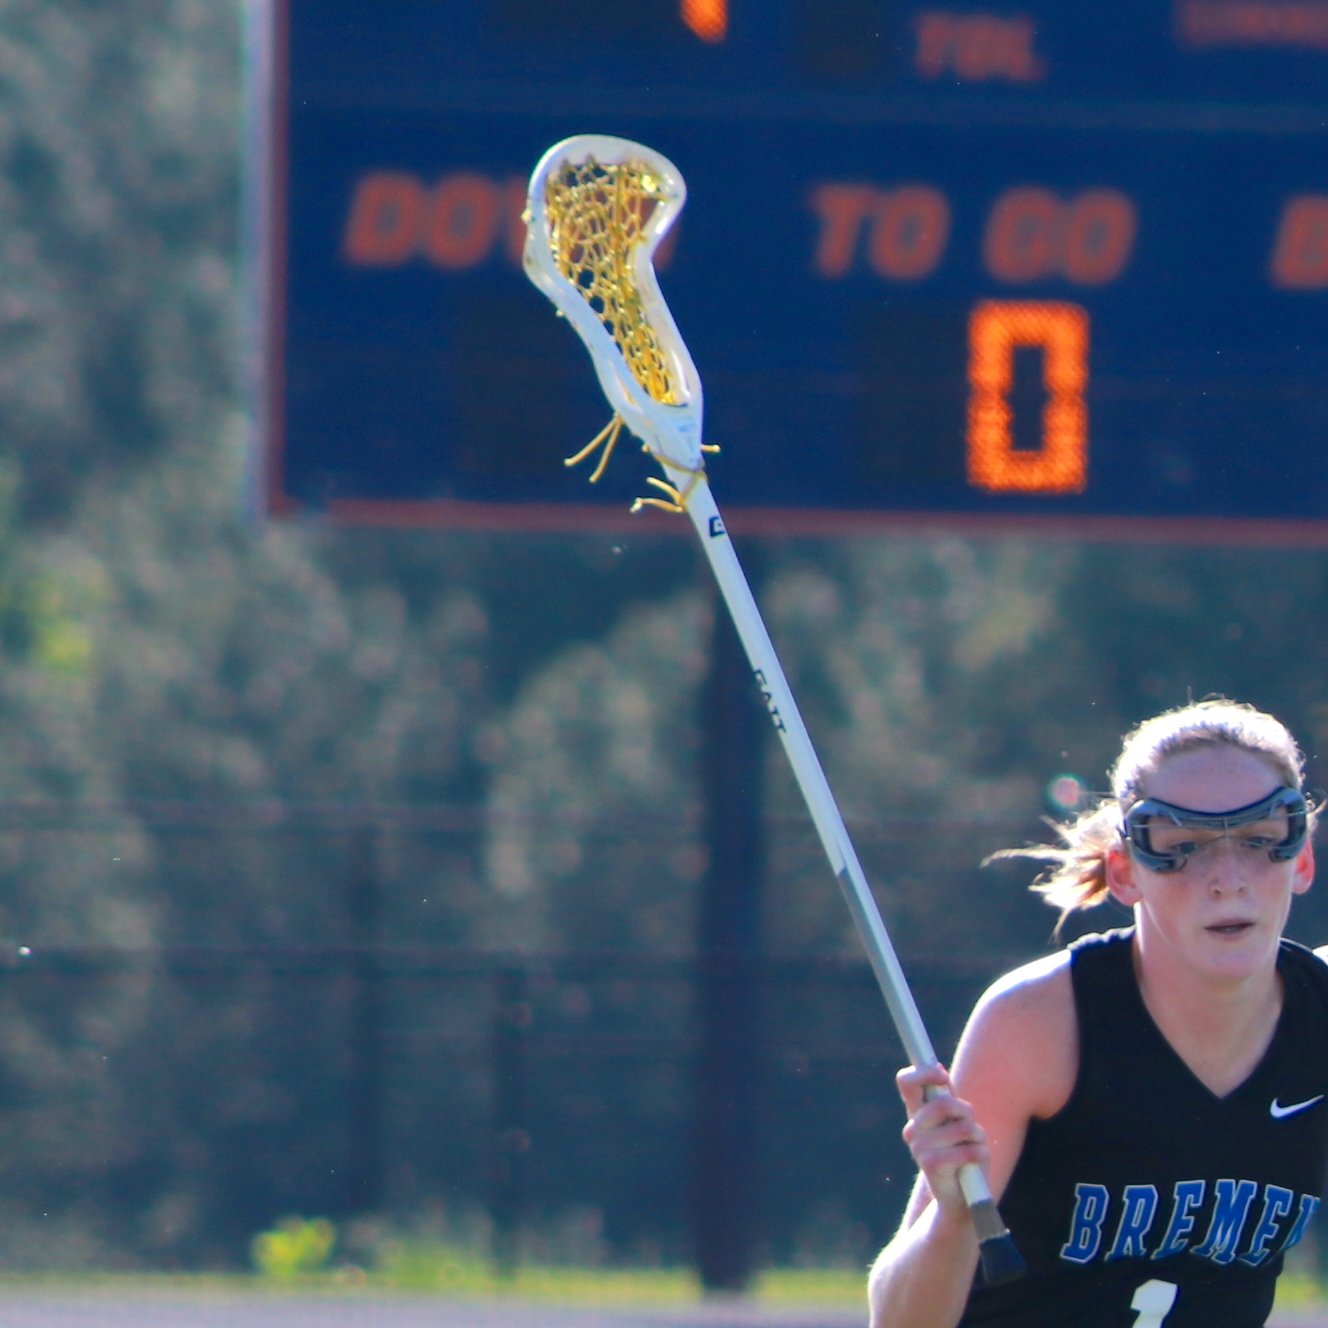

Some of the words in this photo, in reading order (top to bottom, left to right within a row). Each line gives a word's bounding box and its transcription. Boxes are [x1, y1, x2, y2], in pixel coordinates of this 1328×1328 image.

[809, 182, 951, 279] TO
[982, 186, 1138, 286] GO
[966, 299, 1089, 495] 0
